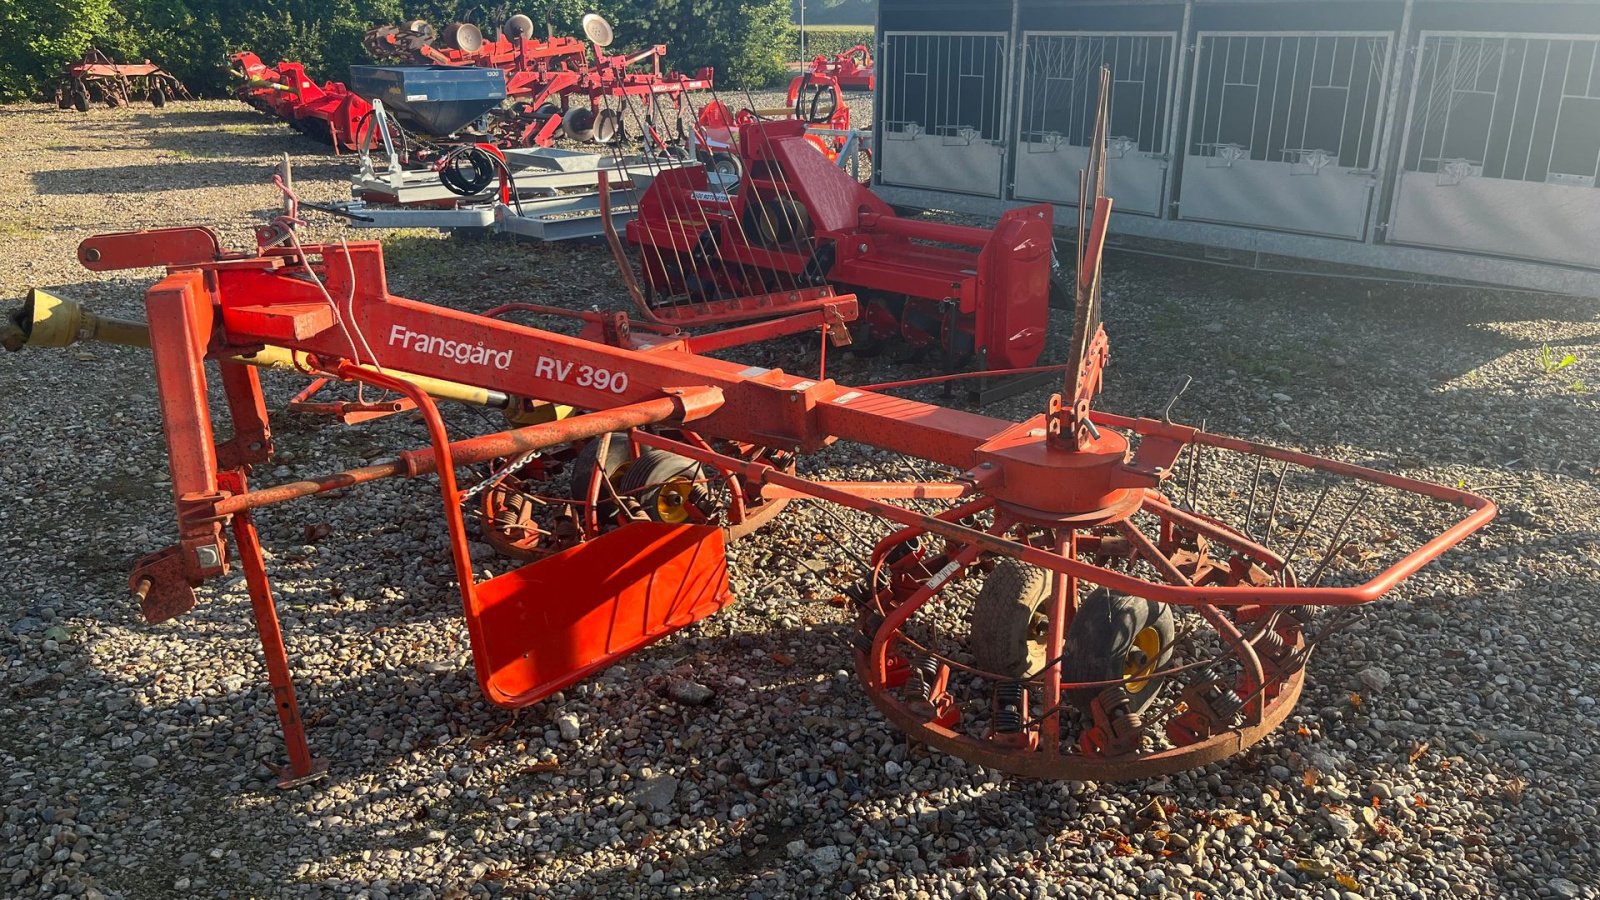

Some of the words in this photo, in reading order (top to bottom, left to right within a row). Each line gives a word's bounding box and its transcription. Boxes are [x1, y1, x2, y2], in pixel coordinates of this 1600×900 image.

[388, 324, 513, 371] Fransgård
[534, 356, 574, 382] RV
[576, 365, 629, 394] 390
